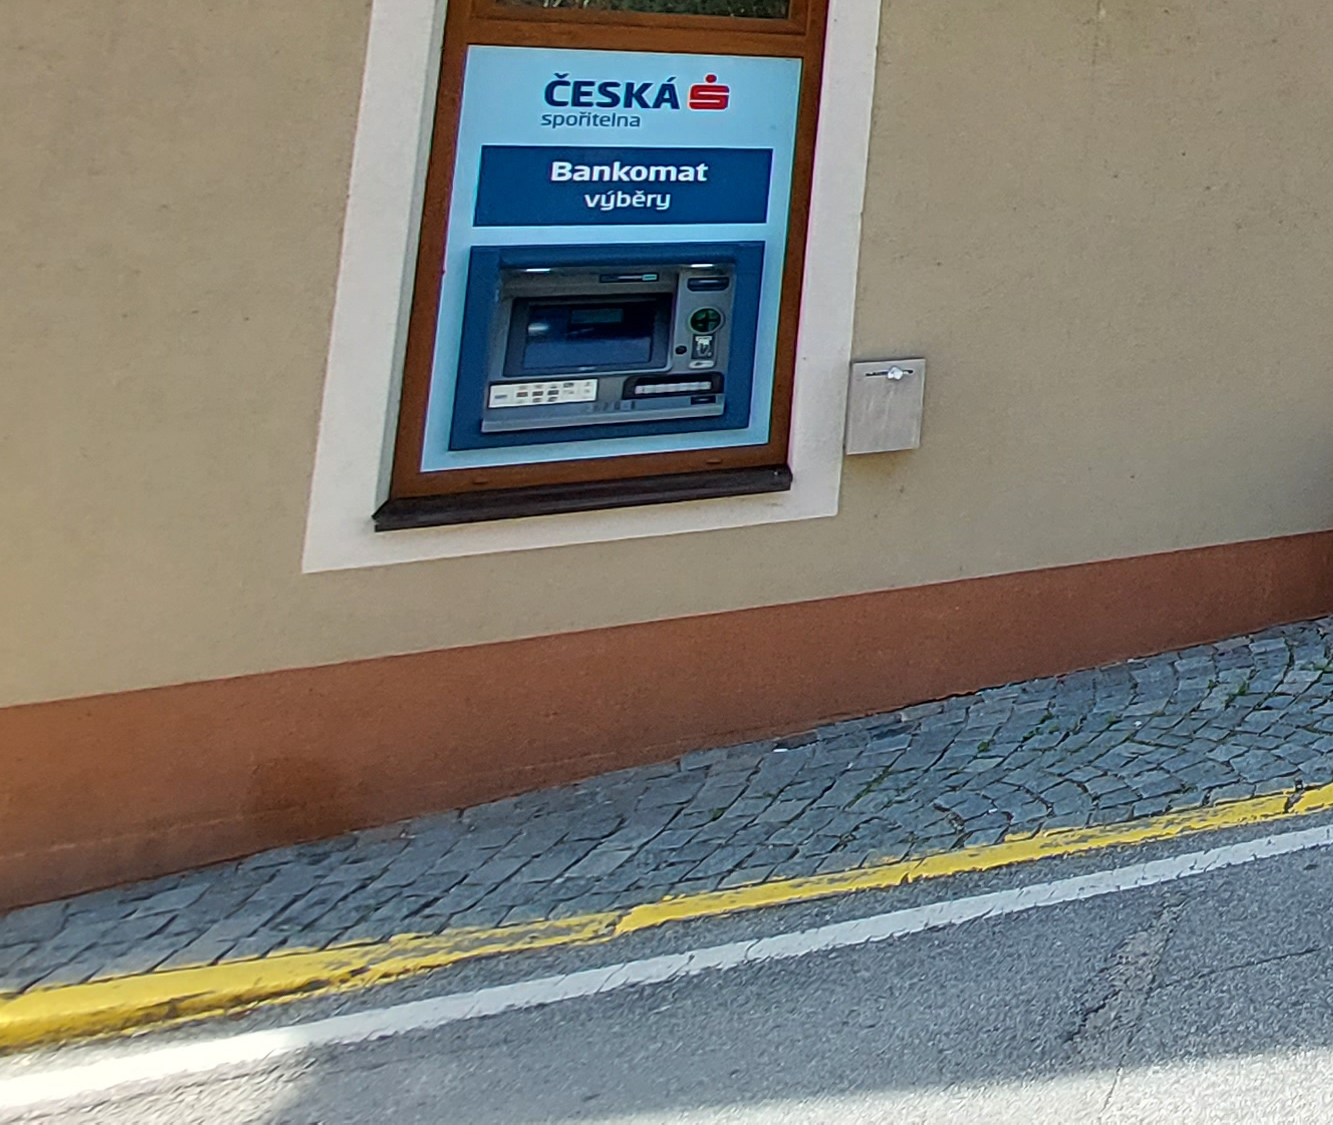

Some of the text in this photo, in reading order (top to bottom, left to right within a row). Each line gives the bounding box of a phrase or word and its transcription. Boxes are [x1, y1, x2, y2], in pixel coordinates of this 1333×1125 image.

[544, 72, 681, 110] ČESKÁ
[541, 112, 641, 129] spořitelna
[551, 161, 709, 182] Bankomat
[584, 190, 671, 211] výběry
